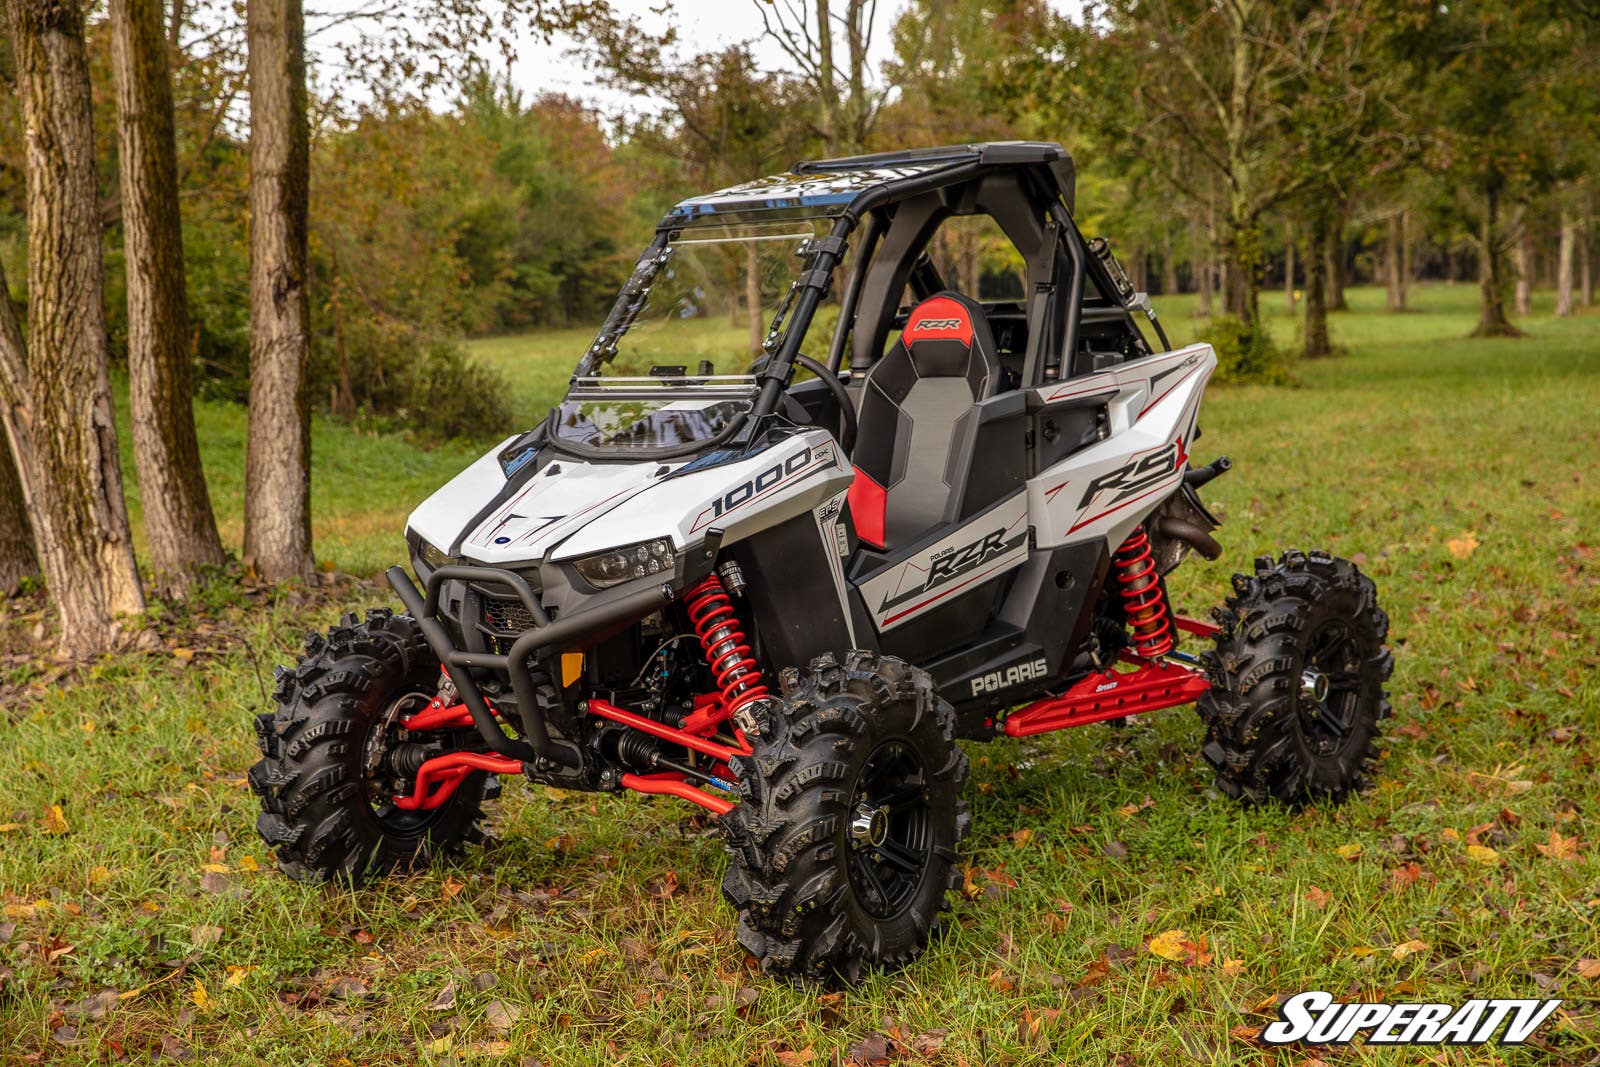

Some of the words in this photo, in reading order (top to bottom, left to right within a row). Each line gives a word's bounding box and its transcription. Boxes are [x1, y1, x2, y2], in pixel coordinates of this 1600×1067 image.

[914, 318, 962, 331] RZR
[712, 446, 811, 518] 1000
[923, 527, 1008, 592] RZR
[930, 546, 955, 561] POLARIS
[971, 658, 1048, 696] POLARIS
